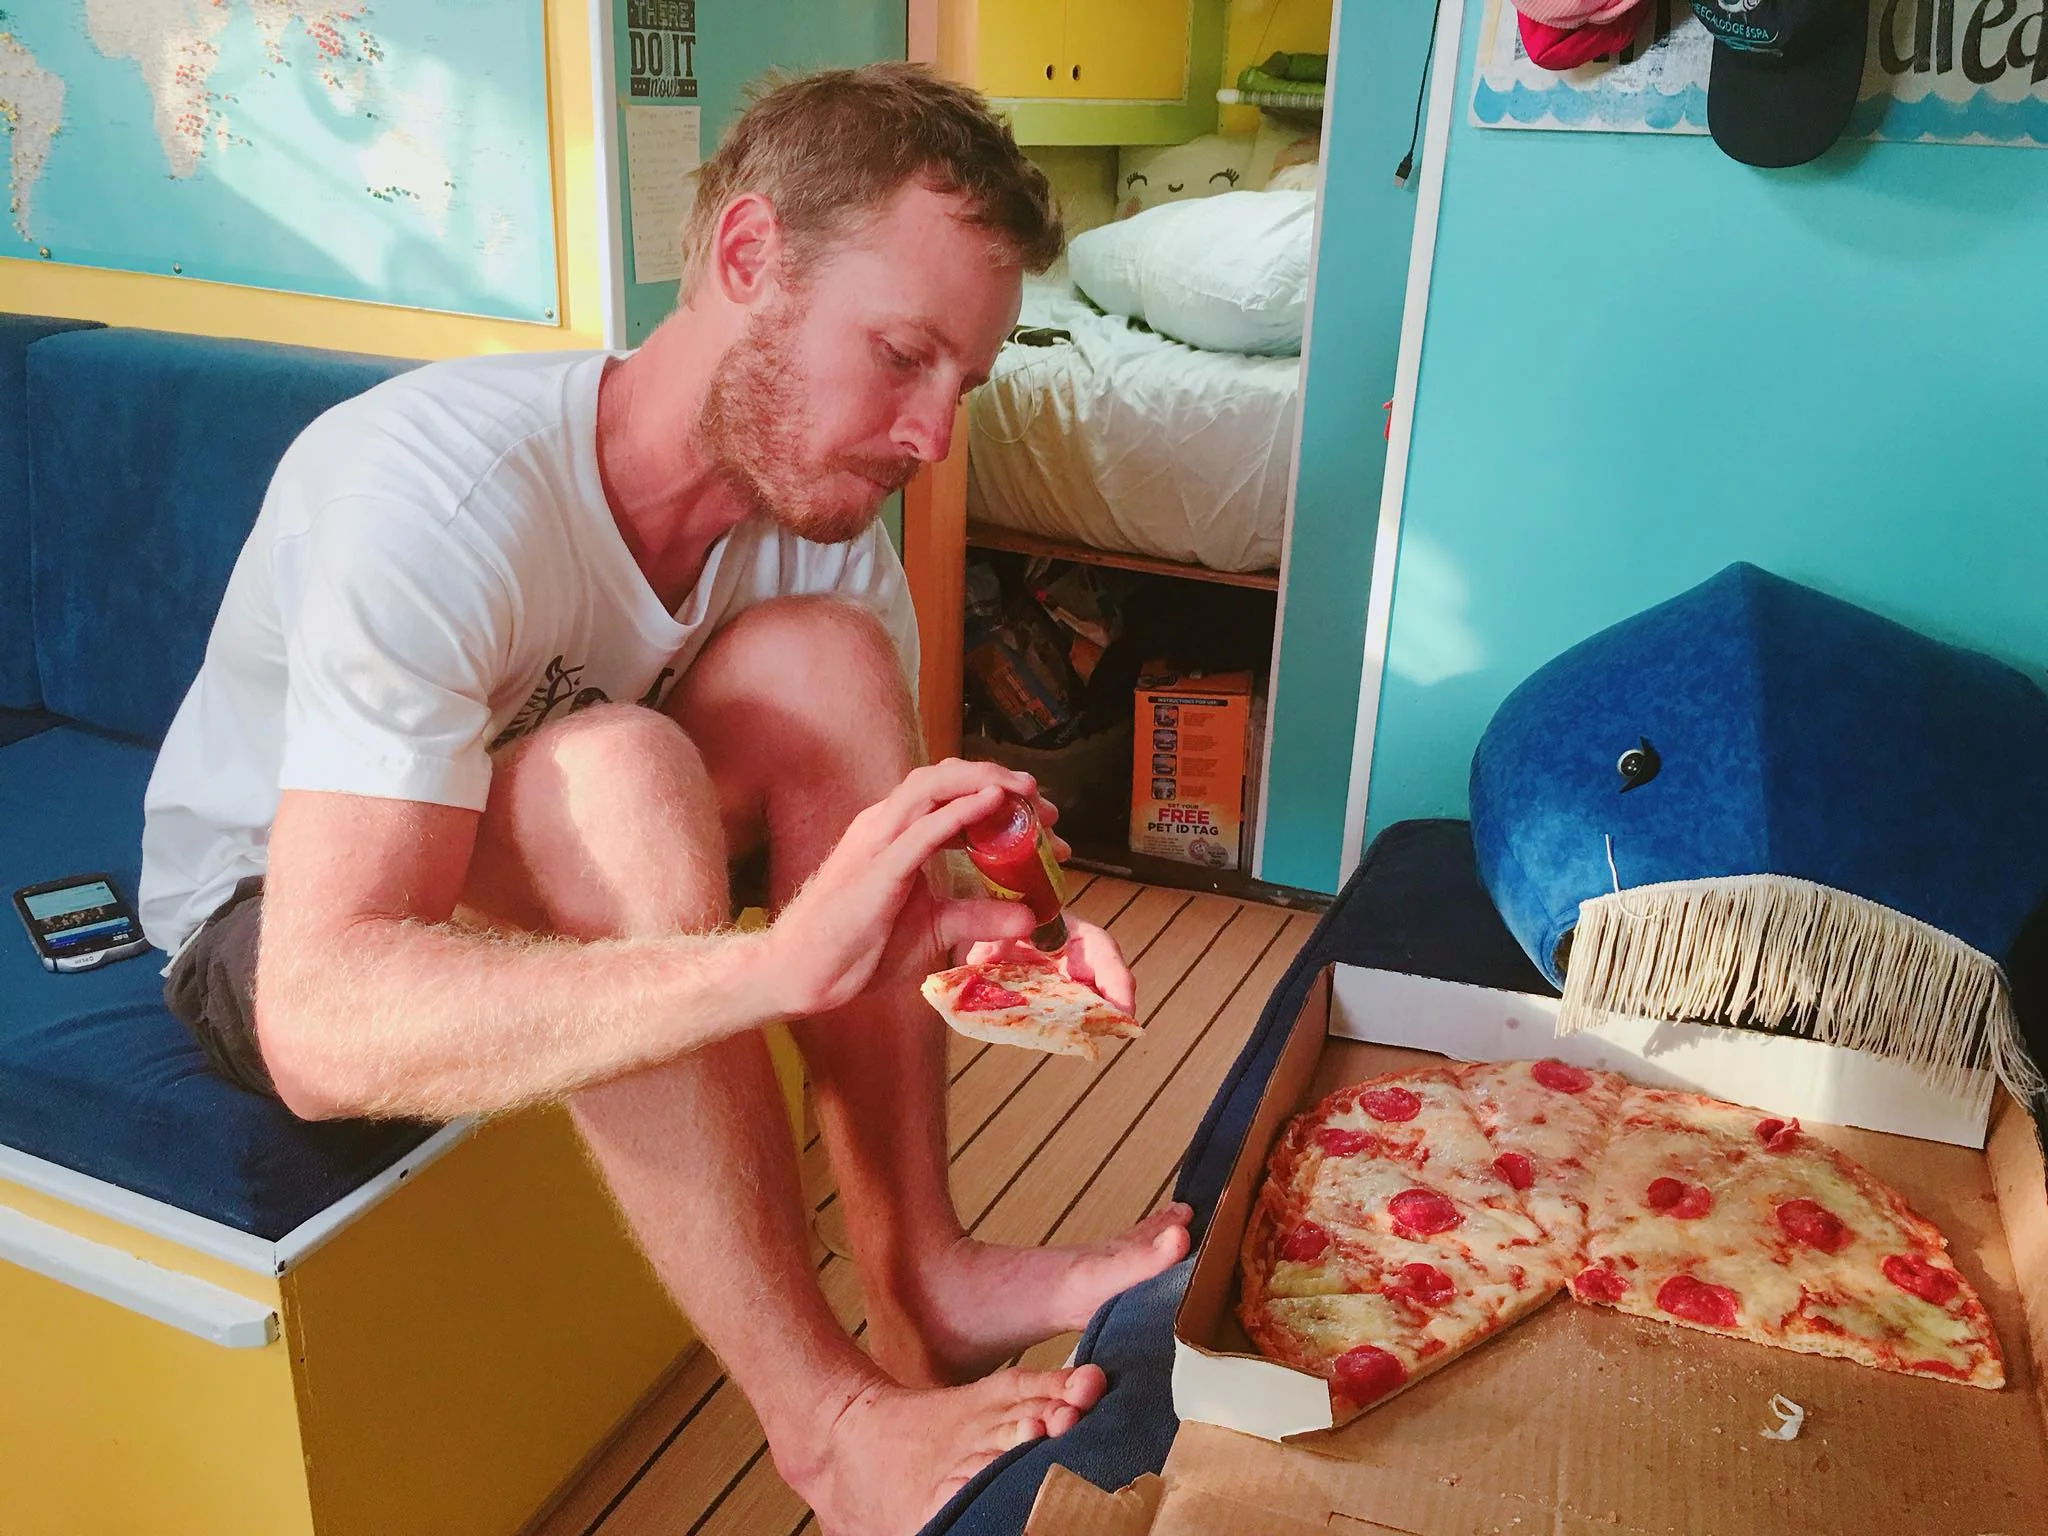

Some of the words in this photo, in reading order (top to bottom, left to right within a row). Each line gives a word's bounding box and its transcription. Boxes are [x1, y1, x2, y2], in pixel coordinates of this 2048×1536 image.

[1750, 28, 1769, 40] SPA
[629, 31, 663, 76] DO
[672, 34, 696, 77] IT
[1158, 807, 1210, 826] FREE
[1148, 822, 1172, 833] PET
[1176, 824, 1190, 834] ID
[1192, 825, 1219, 836] TAG
